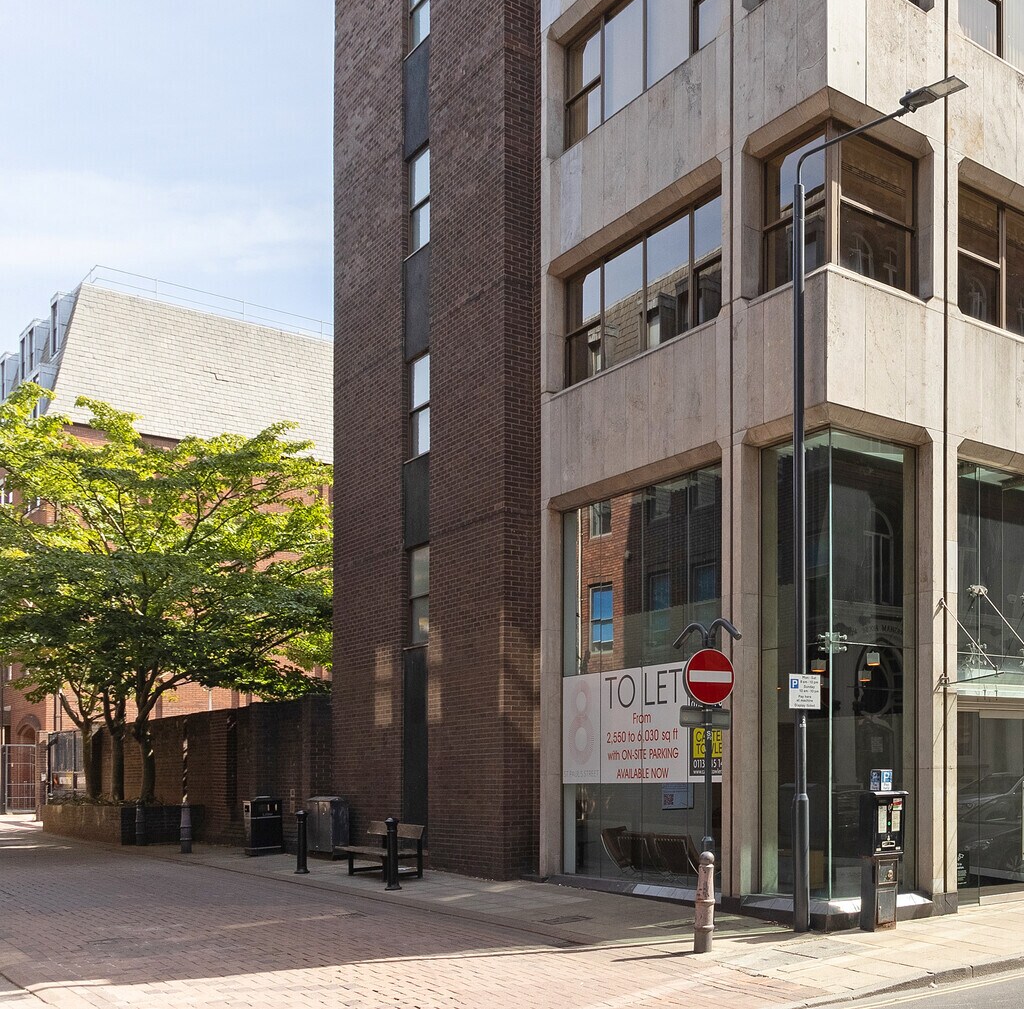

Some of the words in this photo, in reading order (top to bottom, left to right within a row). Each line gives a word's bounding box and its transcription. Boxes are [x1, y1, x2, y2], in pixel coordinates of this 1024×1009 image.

[605, 674, 636, 709] TO
[644, 668, 683, 706] LET
[632, 712, 652, 724] From
[606, 732, 626, 745] 2,550
[627, 731, 636, 743] to
[661, 731, 671, 743] sq
[672, 729, 679, 740] ft
[607, 749, 621, 761] with
[621, 748, 647, 761] ON-SITE
[649, 747, 679, 759] PARKING
[616, 768, 649, 779] AVAILABLE
[651, 767, 669, 779] NOW
